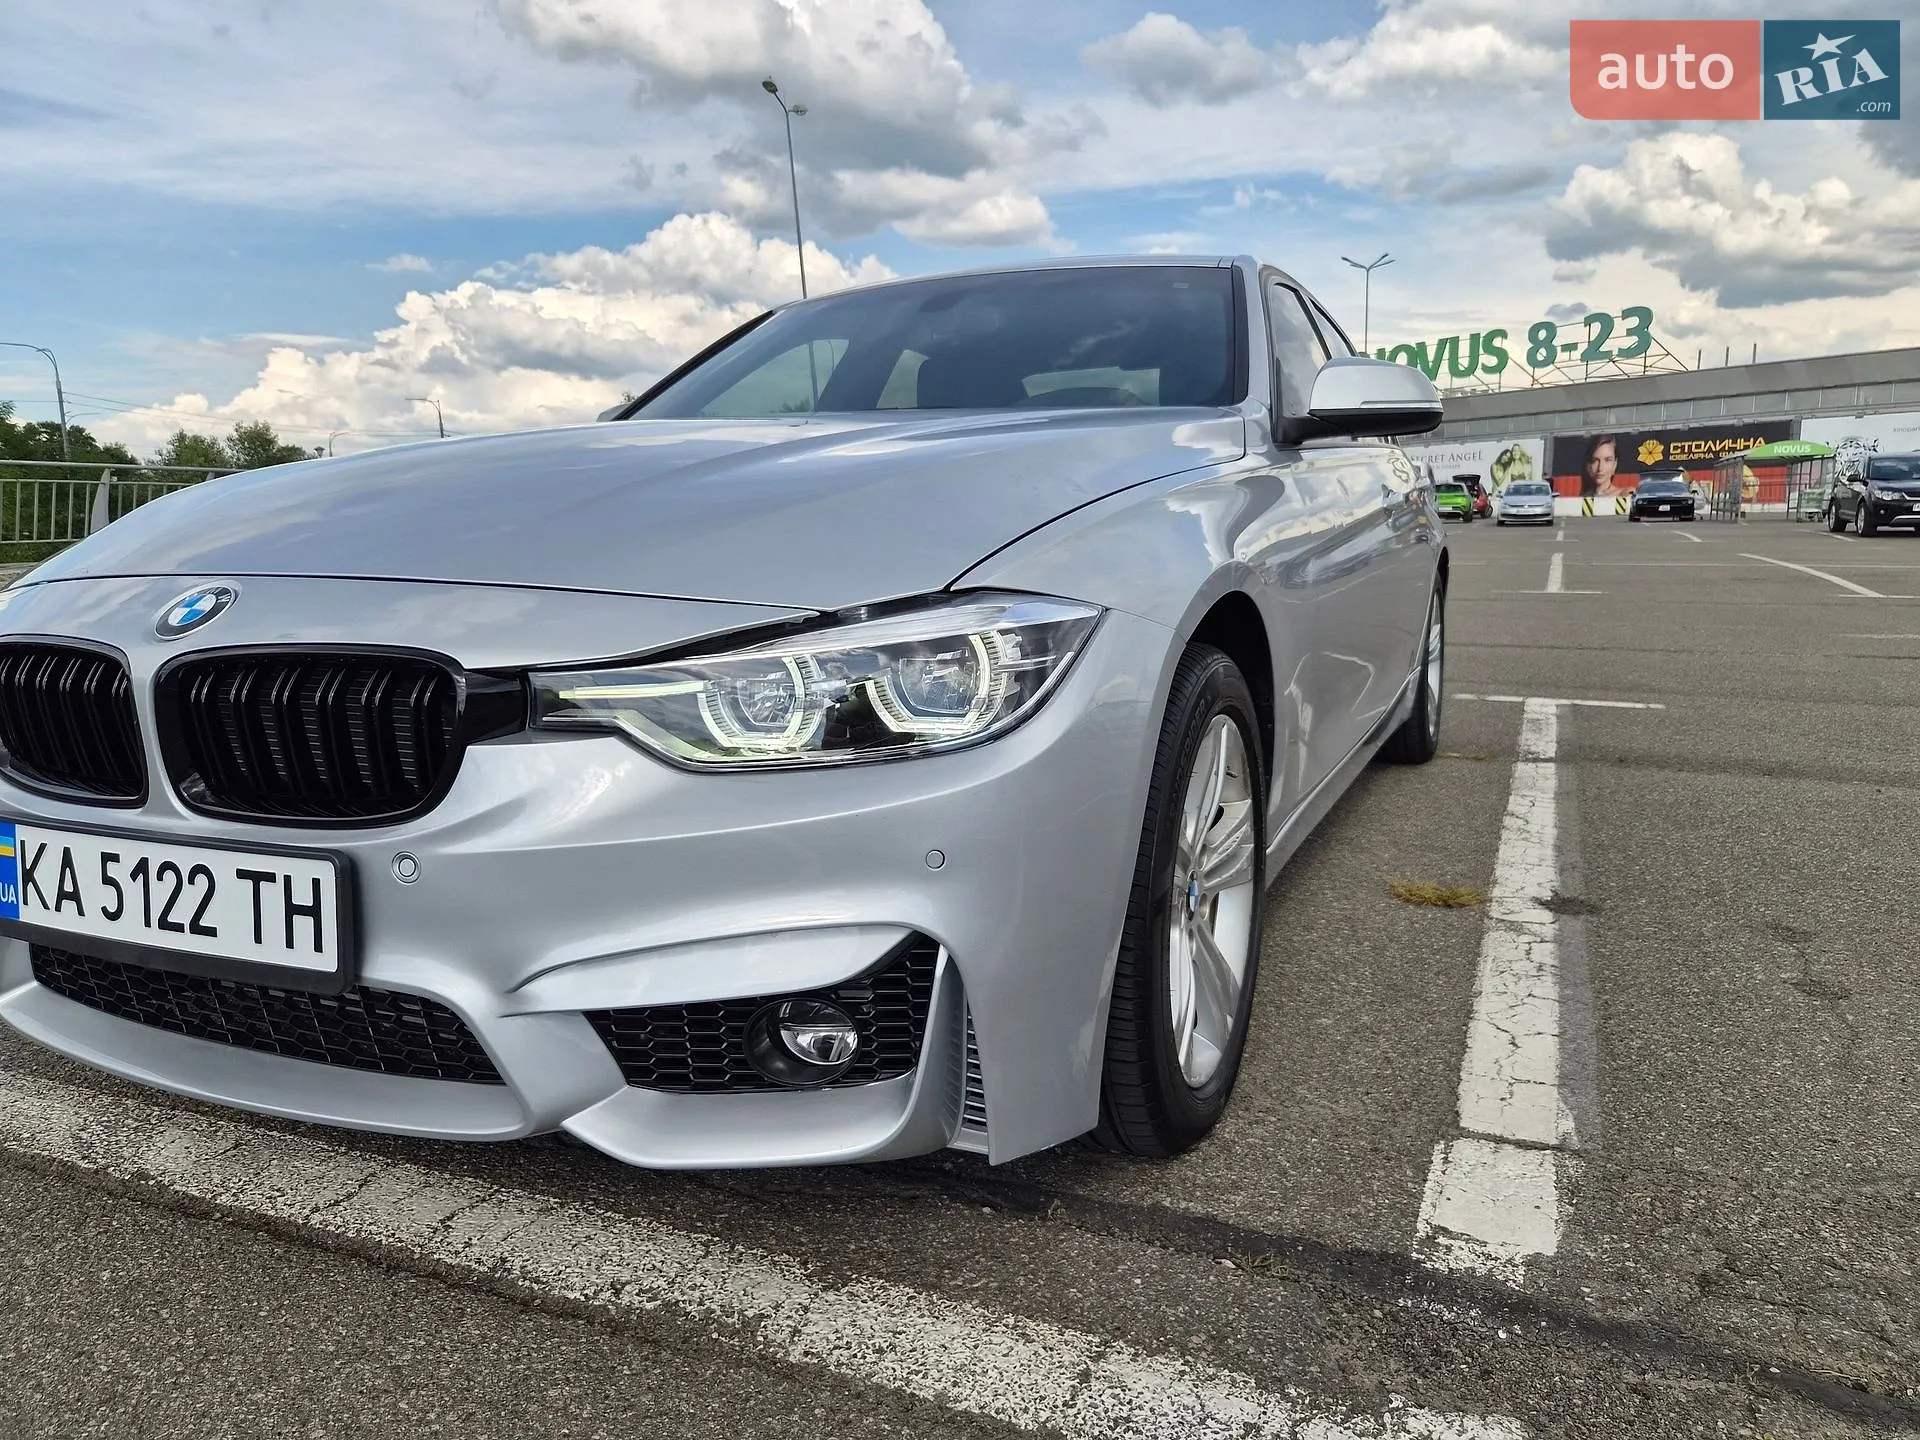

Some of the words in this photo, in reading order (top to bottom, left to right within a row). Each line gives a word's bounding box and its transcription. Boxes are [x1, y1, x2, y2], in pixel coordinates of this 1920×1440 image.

[1358, 328, 1509, 382] OVUS
[1526, 306, 1653, 368] 8-23
[1669, 436, 1766, 454] СТОЛИЧНА
[1774, 444, 1811, 454] NOVUS
[1411, 453, 1446, 464] SECRET
[1449, 450, 1485, 462] ANGEL
[0, 882, 17, 904] UA
[20, 839, 86, 917] KA
[100, 851, 218, 938] 5122
[235, 868, 324, 953] TH
